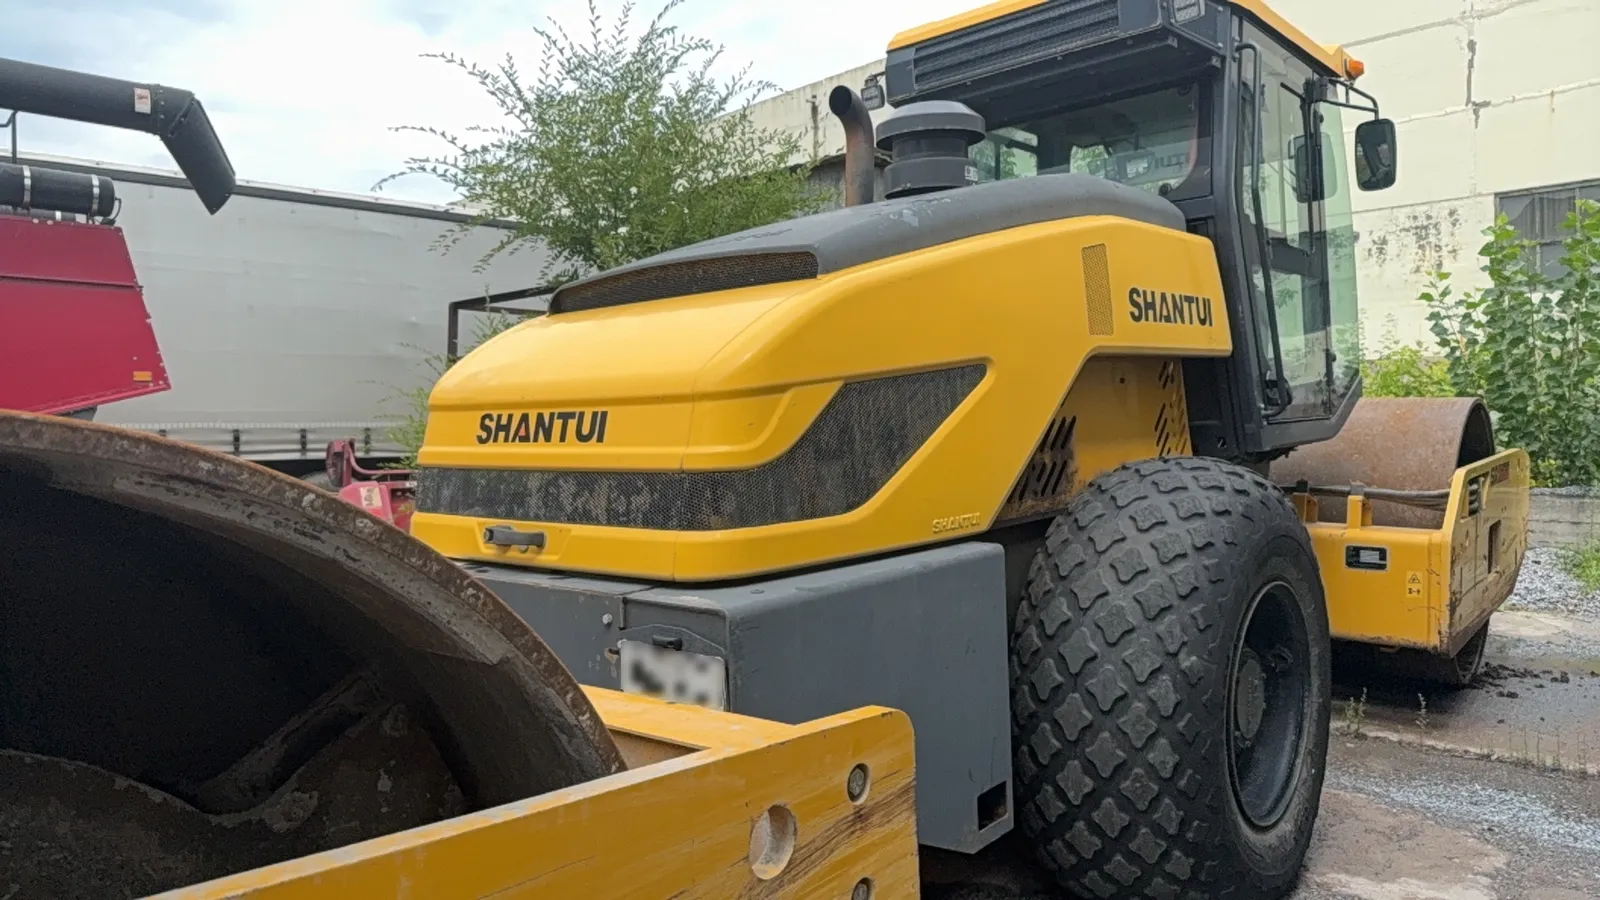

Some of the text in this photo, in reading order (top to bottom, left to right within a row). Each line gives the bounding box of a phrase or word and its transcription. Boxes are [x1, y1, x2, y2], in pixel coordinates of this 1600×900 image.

[1128, 287, 1213, 327] SHANTUI
[476, 410, 608, 445] SHANTUI
[932, 512, 981, 534] SHANTUI
